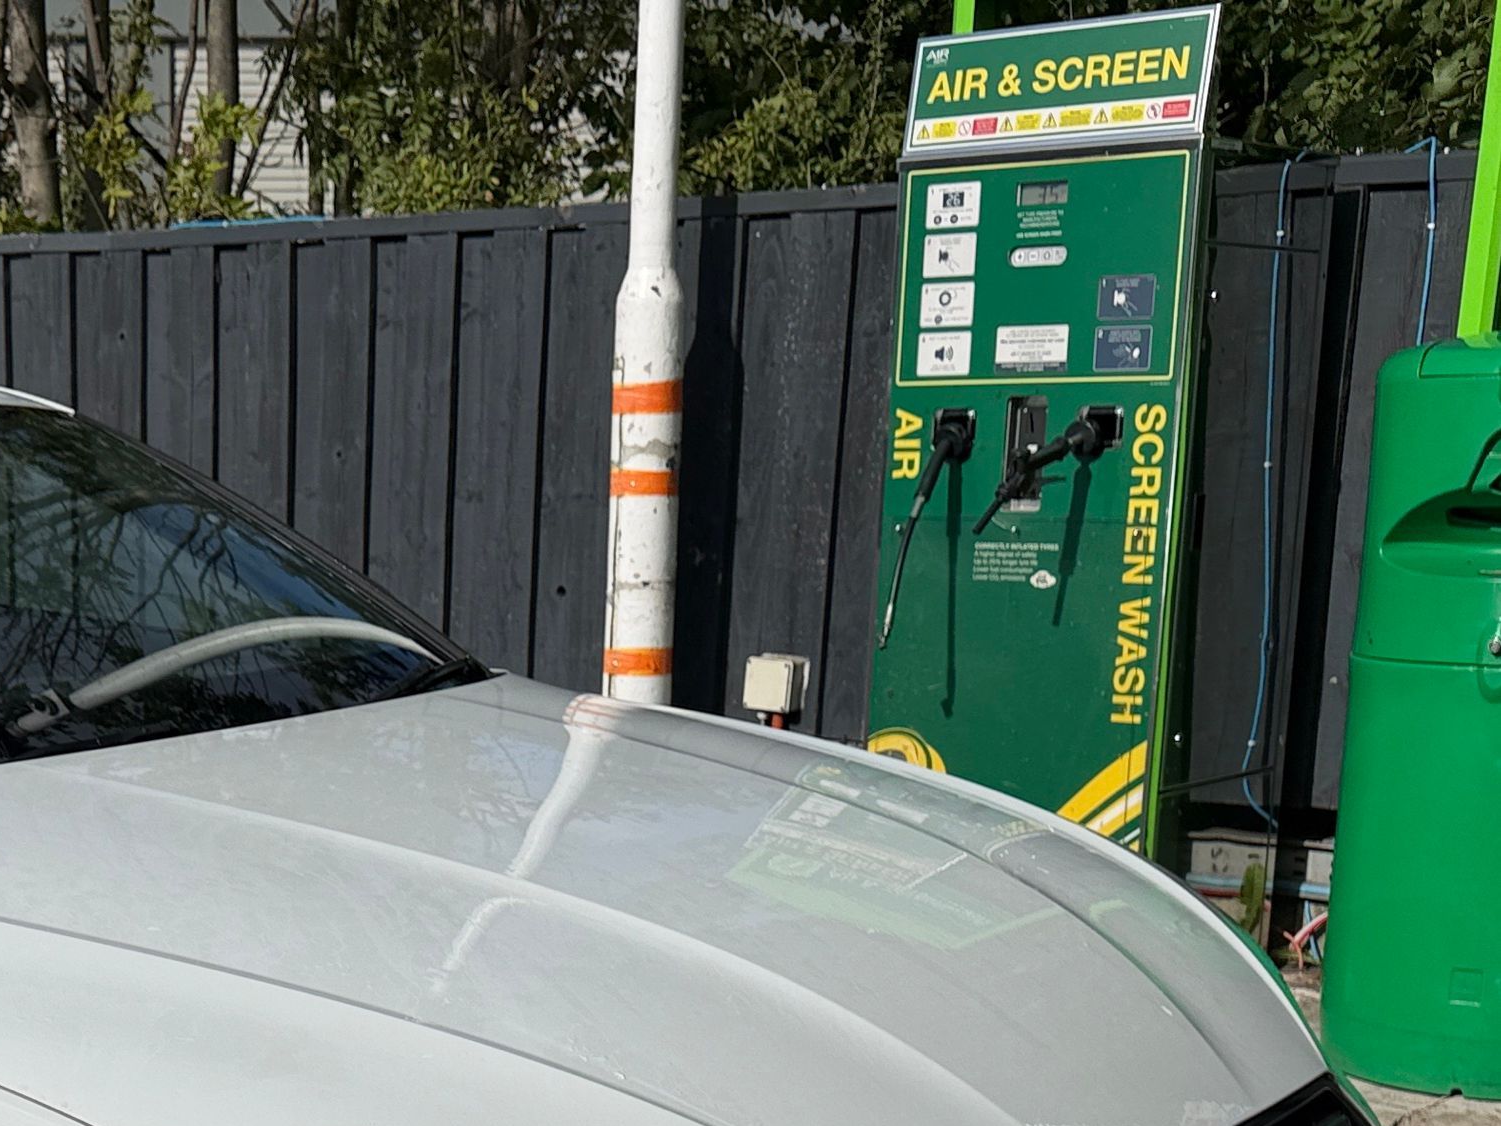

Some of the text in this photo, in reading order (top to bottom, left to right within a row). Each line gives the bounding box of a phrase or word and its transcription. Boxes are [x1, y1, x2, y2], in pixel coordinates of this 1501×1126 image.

[926, 45, 1191, 105] AIR & SCREEN
[892, 408, 923, 479] AIR
[1122, 403, 1167, 585] SCREEN
[1110, 597, 1152, 725] WASH
